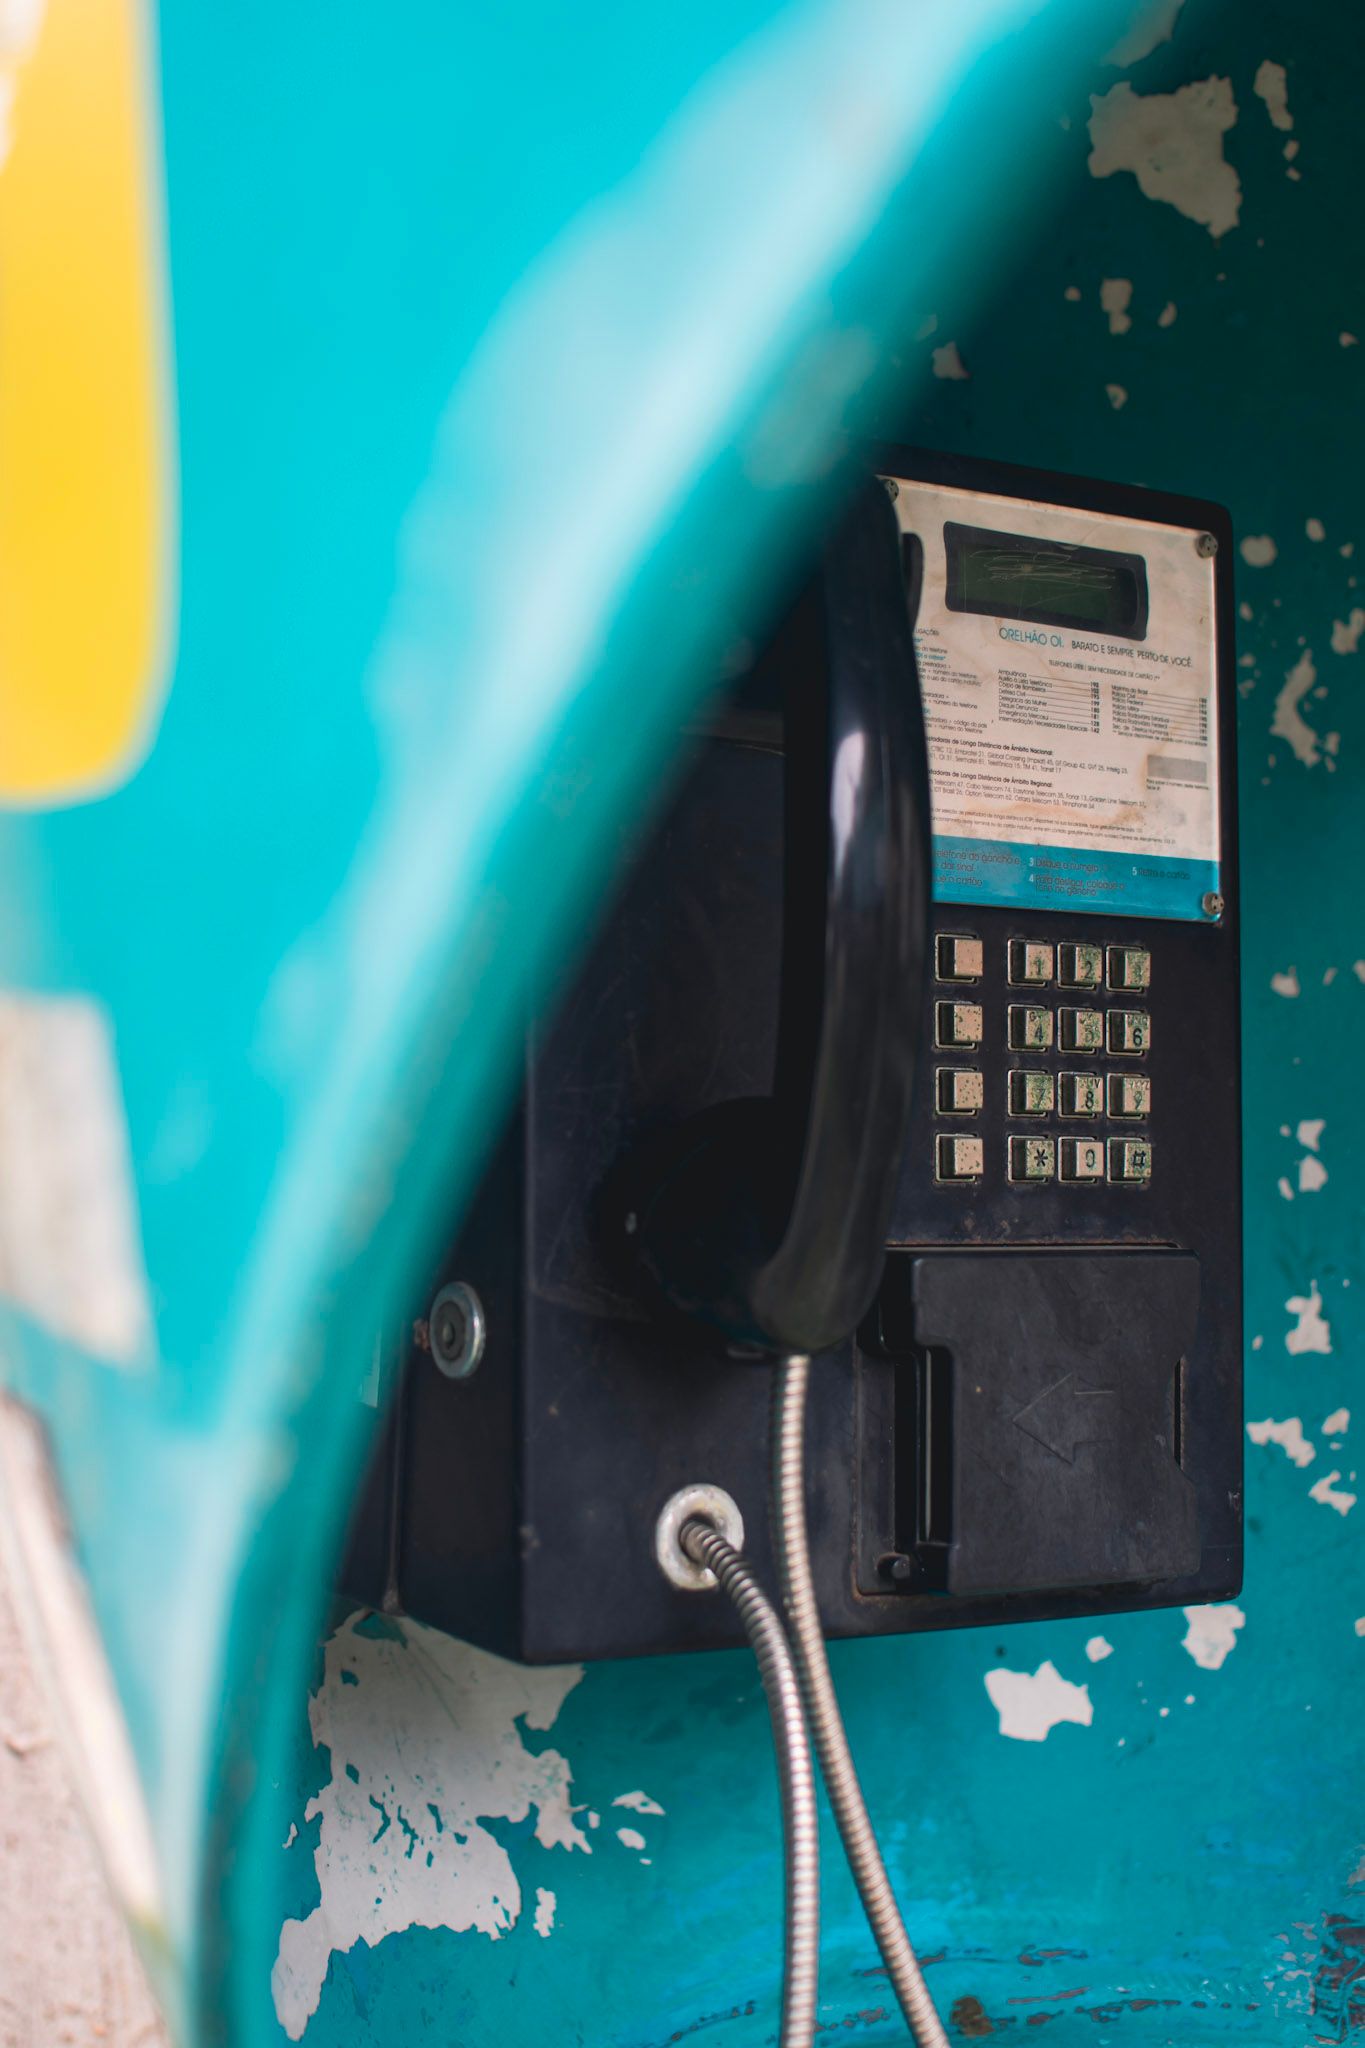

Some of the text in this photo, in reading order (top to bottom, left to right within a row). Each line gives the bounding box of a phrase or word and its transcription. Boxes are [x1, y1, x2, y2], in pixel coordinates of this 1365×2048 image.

[999, 627, 1047, 646] ORELHÃO
[1072, 640, 1099, 653] BARATO
[1101, 644, 1105, 654] E
[1107, 645, 1134, 658] SEMPRE
[1137, 650, 1158, 662] PERTO
[960, 739, 976, 747] Longa
[978, 741, 1001, 750] Distância
[1011, 744, 1029, 752] Âmbito
[978, 774, 1001, 782] Distância
[1011, 777, 1029, 785] Âmbito
[1029, 857, 1034, 867] 3
[1132, 866, 1137, 876] 5
[1029, 874, 1033, 882] 4
[1034, 957, 1044, 976] 1
[1084, 960, 1093, 980] 2
[1034, 1025, 1044, 1042] 4
[1133, 1028, 1142, 1047] 6
[1085, 1090, 1094, 1110] 8
[1134, 1090, 1143, 1110] 9
[1085, 1149, 1095, 1168] 0
